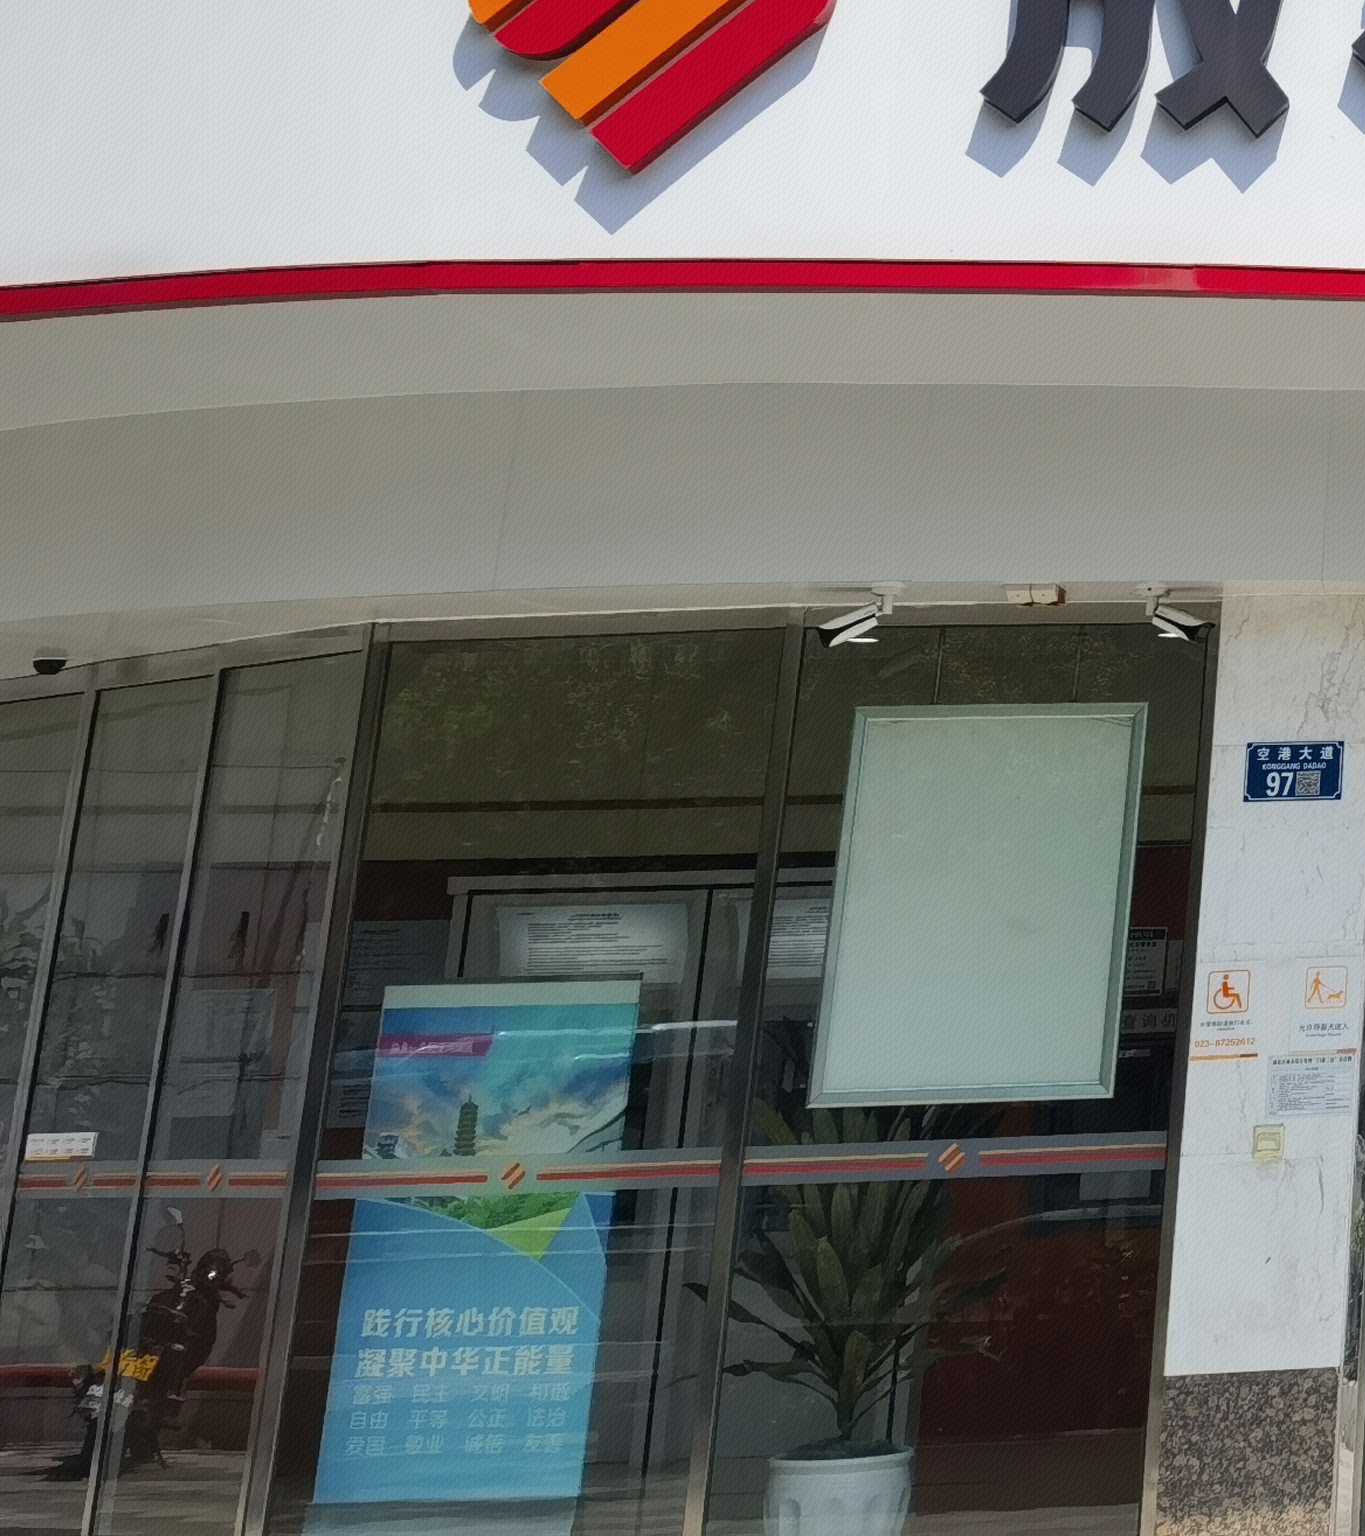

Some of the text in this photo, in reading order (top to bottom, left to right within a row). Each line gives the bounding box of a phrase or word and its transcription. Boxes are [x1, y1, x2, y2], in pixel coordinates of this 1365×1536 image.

[1257, 746, 1334, 761] 空港大道
[1262, 762, 1327, 771] KONGGANG DADAO
[1265, 772, 1295, 797] 97
[361, 1306, 581, 1339] 践行核心价值观
[355, 1345, 576, 1378] 凝聚中华正能量
[350, 1407, 567, 1430] 自由 平等 公正 法治
[344, 1435, 387, 1457] 爱国
